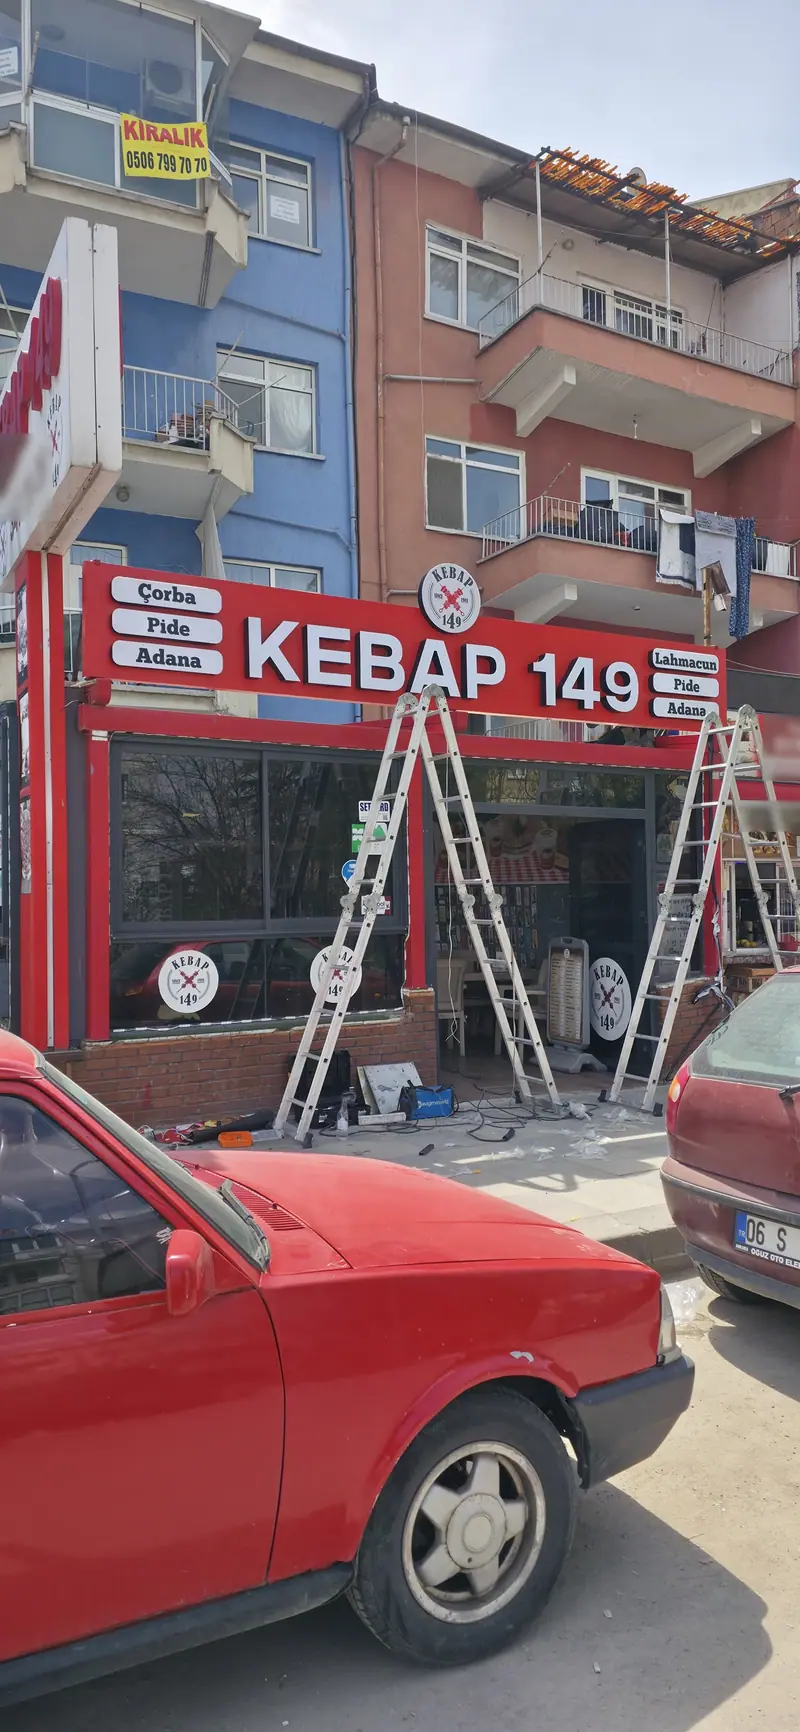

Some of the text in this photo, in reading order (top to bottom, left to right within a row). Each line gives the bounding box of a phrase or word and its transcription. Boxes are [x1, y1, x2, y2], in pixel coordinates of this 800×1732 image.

[126, 150, 207, 174] 0506 799 70 70
[432, 566, 474, 587] KEBAP
[137, 582, 197, 606] Çorba
[147, 616, 190, 637] Pide
[442, 612, 462, 630] 149
[135, 647, 202, 669] Adana
[244, 615, 639, 713] KEBAP 149
[654, 652, 718, 672] Lahmacun
[673, 678, 700, 694] Pide
[667, 702, 707, 718] Adana
[171, 955, 210, 970] KEBAP
[593, 965, 624, 986] KEBAP
[179, 993, 198, 1006] 149
[600, 1013, 615, 1031] 149
[746, 1219, 788, 1252] 06 S
[769, 1254, 785, 1264] OTO
